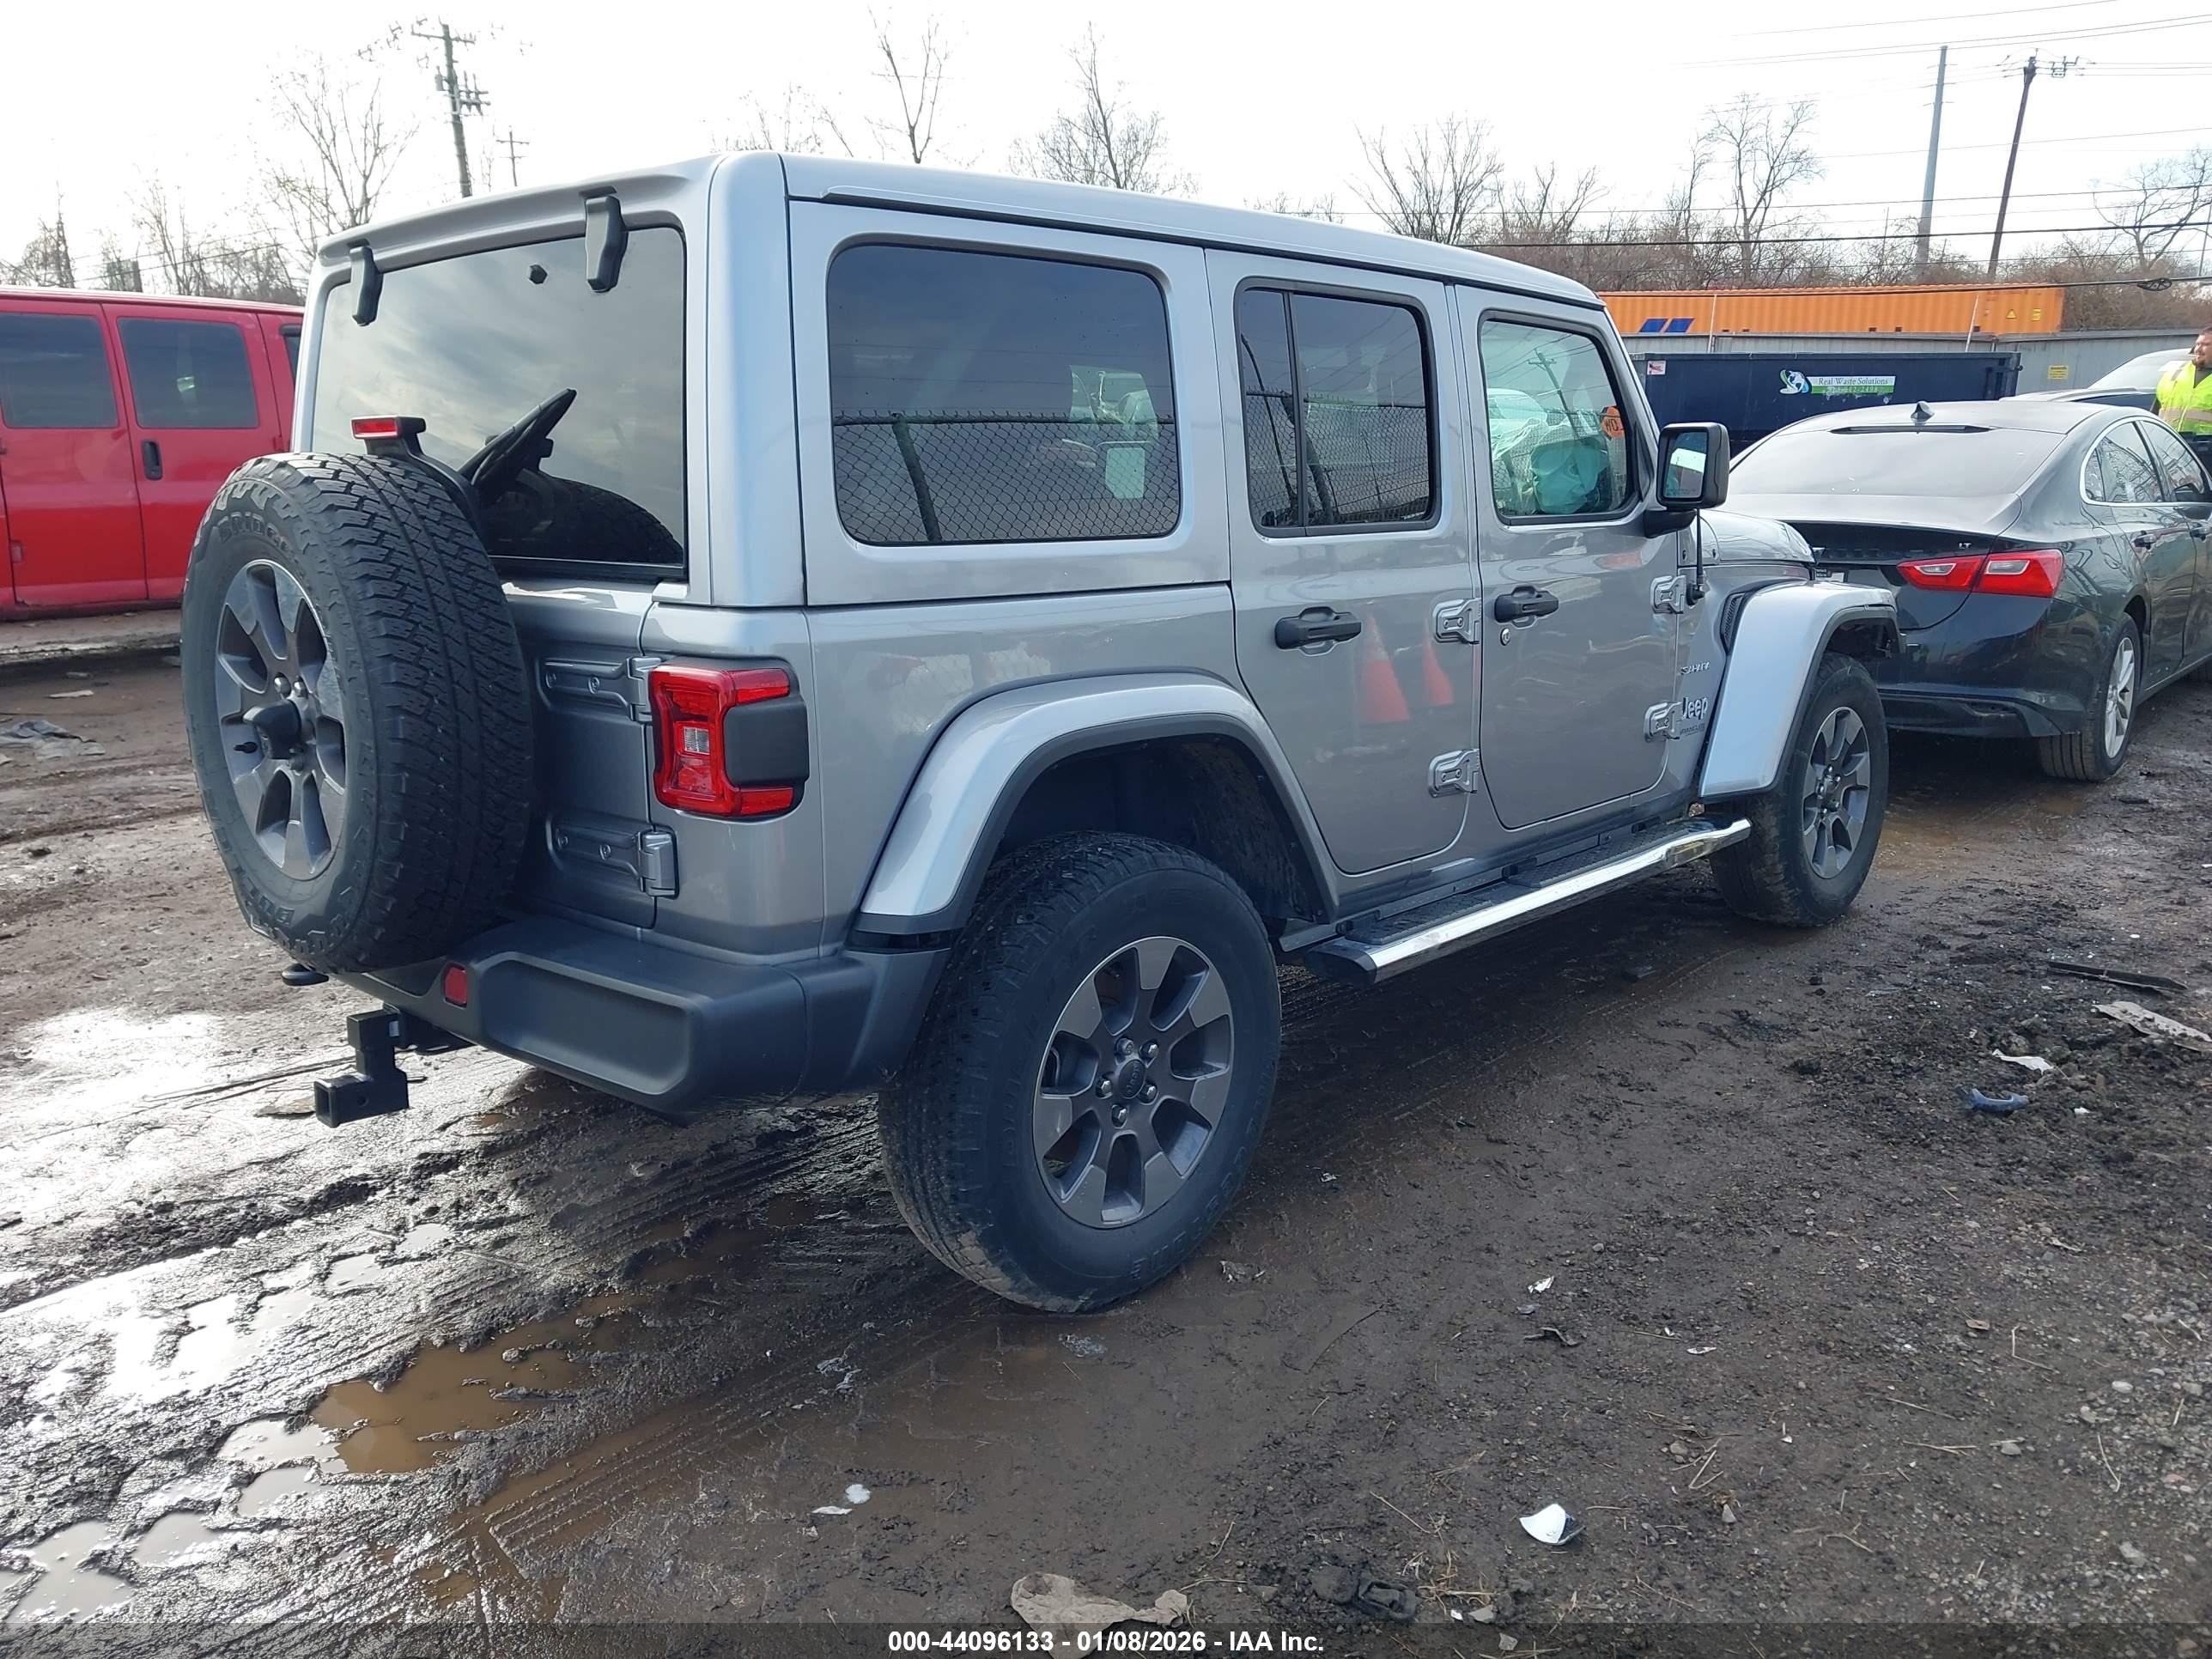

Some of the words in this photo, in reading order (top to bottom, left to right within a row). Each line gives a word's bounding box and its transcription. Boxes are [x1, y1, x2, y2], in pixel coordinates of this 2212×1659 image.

[1818, 377, 1833, 386] Real
[1836, 377, 1856, 386] Waste
[1858, 377, 1888, 386] Solutions
[1682, 696, 1708, 720] Jeep
